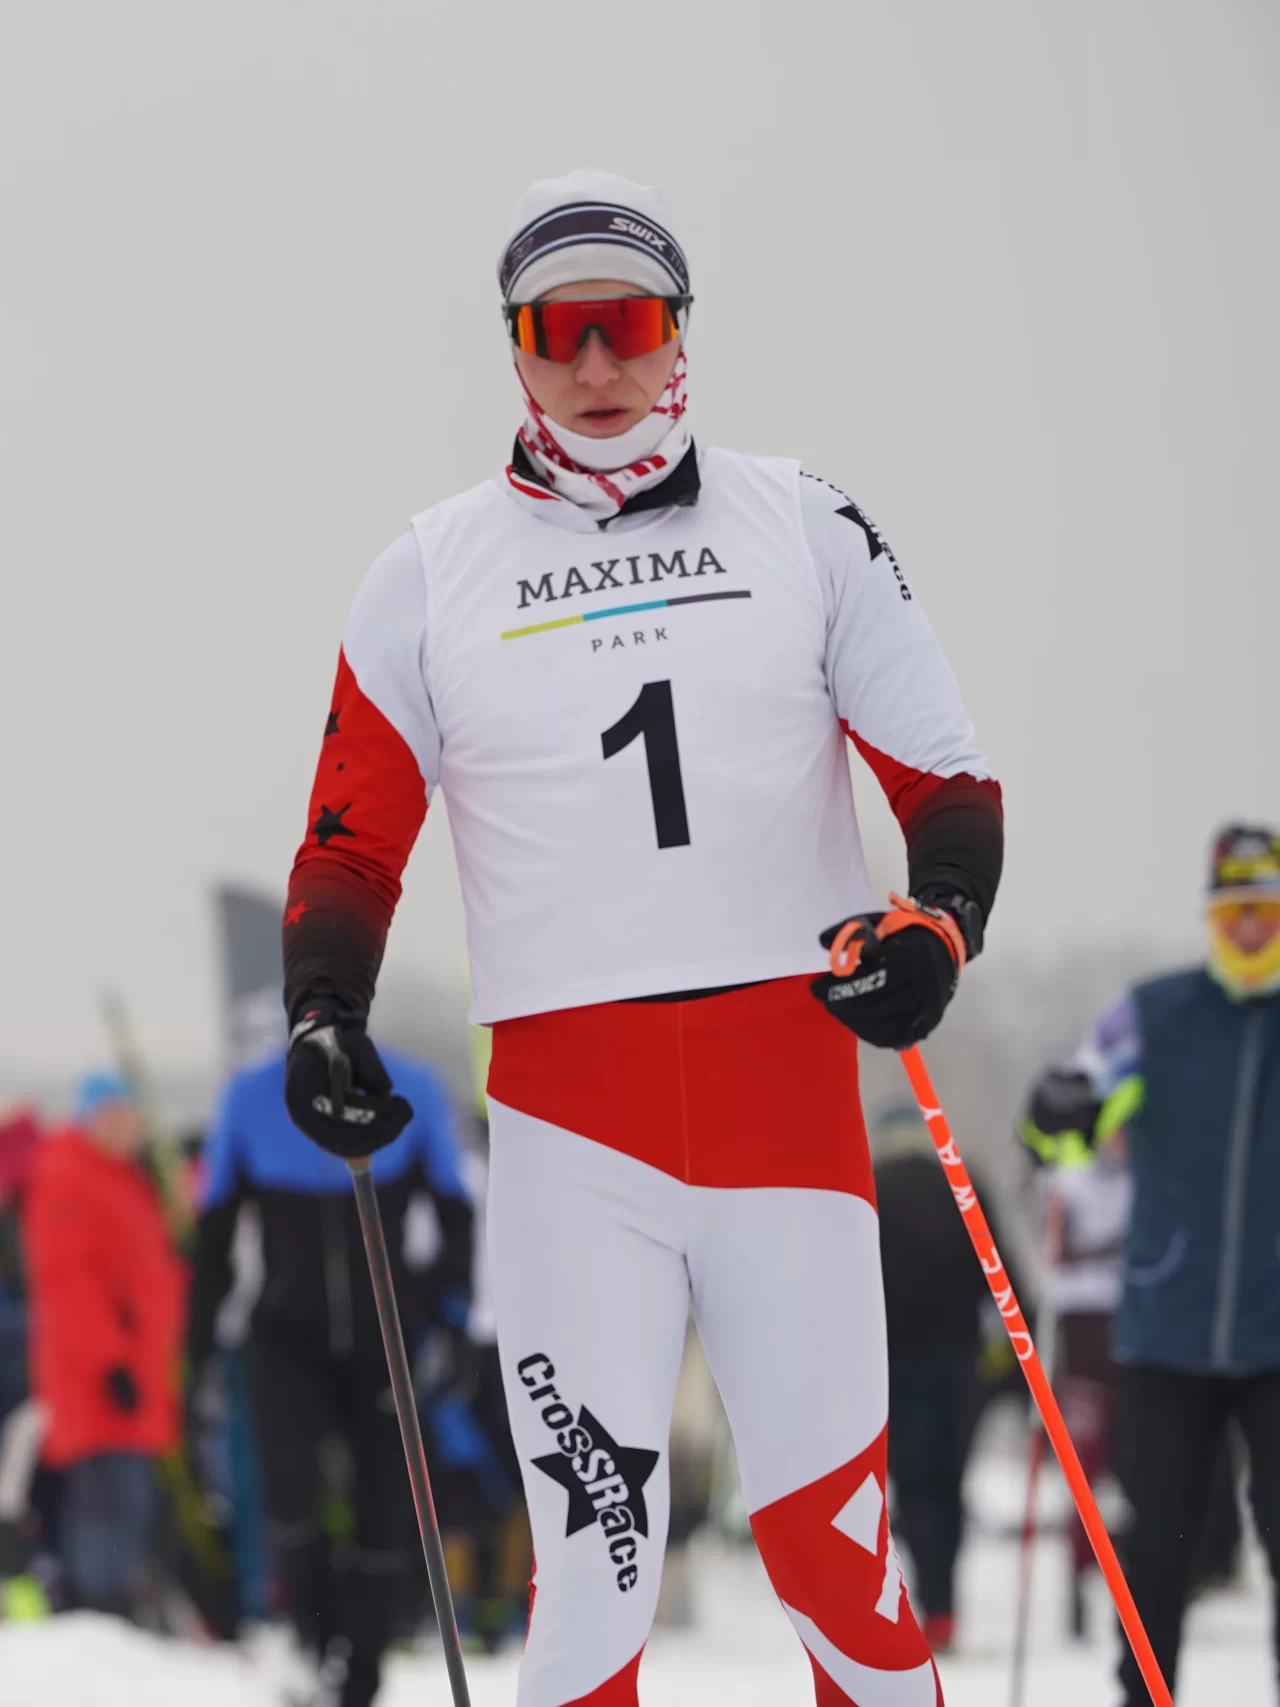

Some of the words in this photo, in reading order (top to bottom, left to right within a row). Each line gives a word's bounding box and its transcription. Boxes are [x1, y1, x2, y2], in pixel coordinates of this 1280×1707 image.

[516, 547, 726, 609] MAXIMA
[591, 627, 668, 653] PARK
[601, 679, 691, 849] 1
